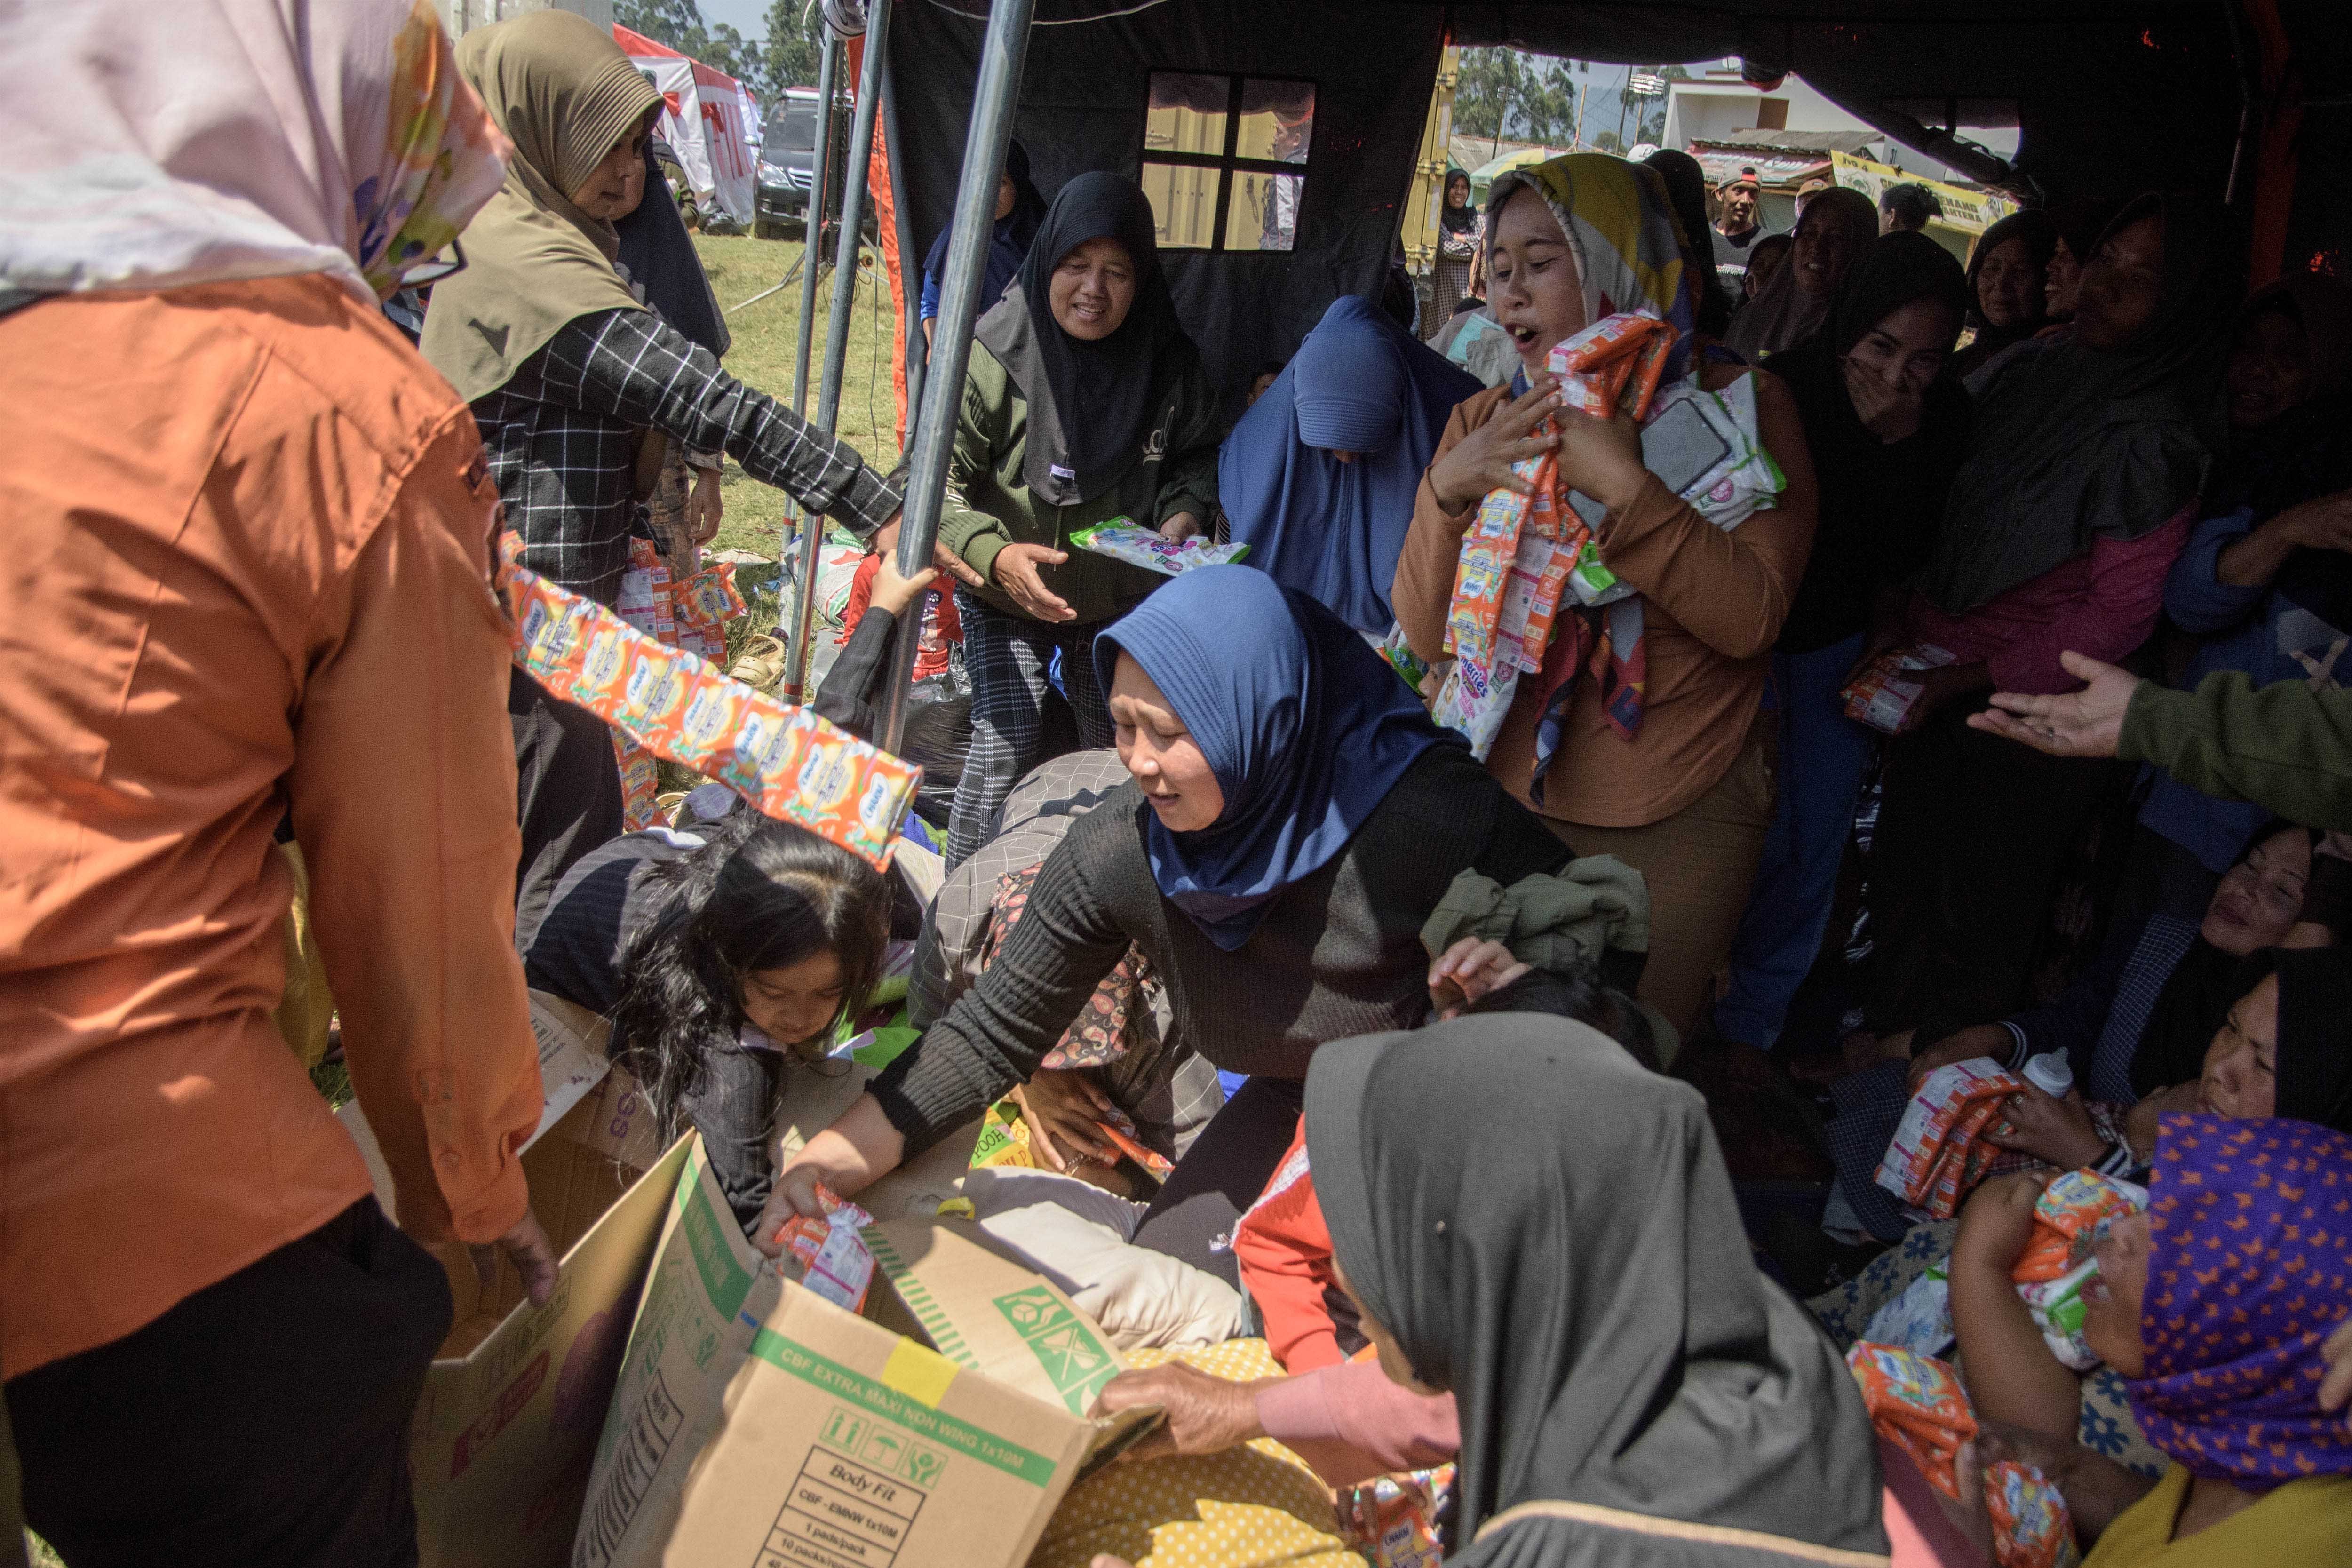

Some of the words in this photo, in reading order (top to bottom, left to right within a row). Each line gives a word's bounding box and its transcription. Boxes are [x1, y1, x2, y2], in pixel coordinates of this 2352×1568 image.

[717, 589, 727, 607] CHARM
[1464, 582, 1481, 592] CHARM
[526, 609, 543, 639] CHARM
[629, 666, 648, 696] CHARM
[1460, 658, 1488, 697] merries
[684, 695, 705, 726] CHARM
[801, 753, 820, 785] CHARM
[866, 785, 885, 818] CHARM
[974, 1130, 1005, 1159] POOH
[780, 1347, 813, 1370] CBF
[814, 1364, 861, 1397] EXTRA
[865, 1386, 902, 1415] MAXI
[904, 1405, 937, 1431] NON
[938, 1420, 978, 1449] WING
[799, 1488, 823, 1504] CBF
[830, 1464, 872, 1492] Body
[872, 1482, 897, 1502] Fit
[782, 1538, 794, 1550] 10
[806, 1523, 812, 1532] 1
[812, 1528, 867, 1556] pads/pack
